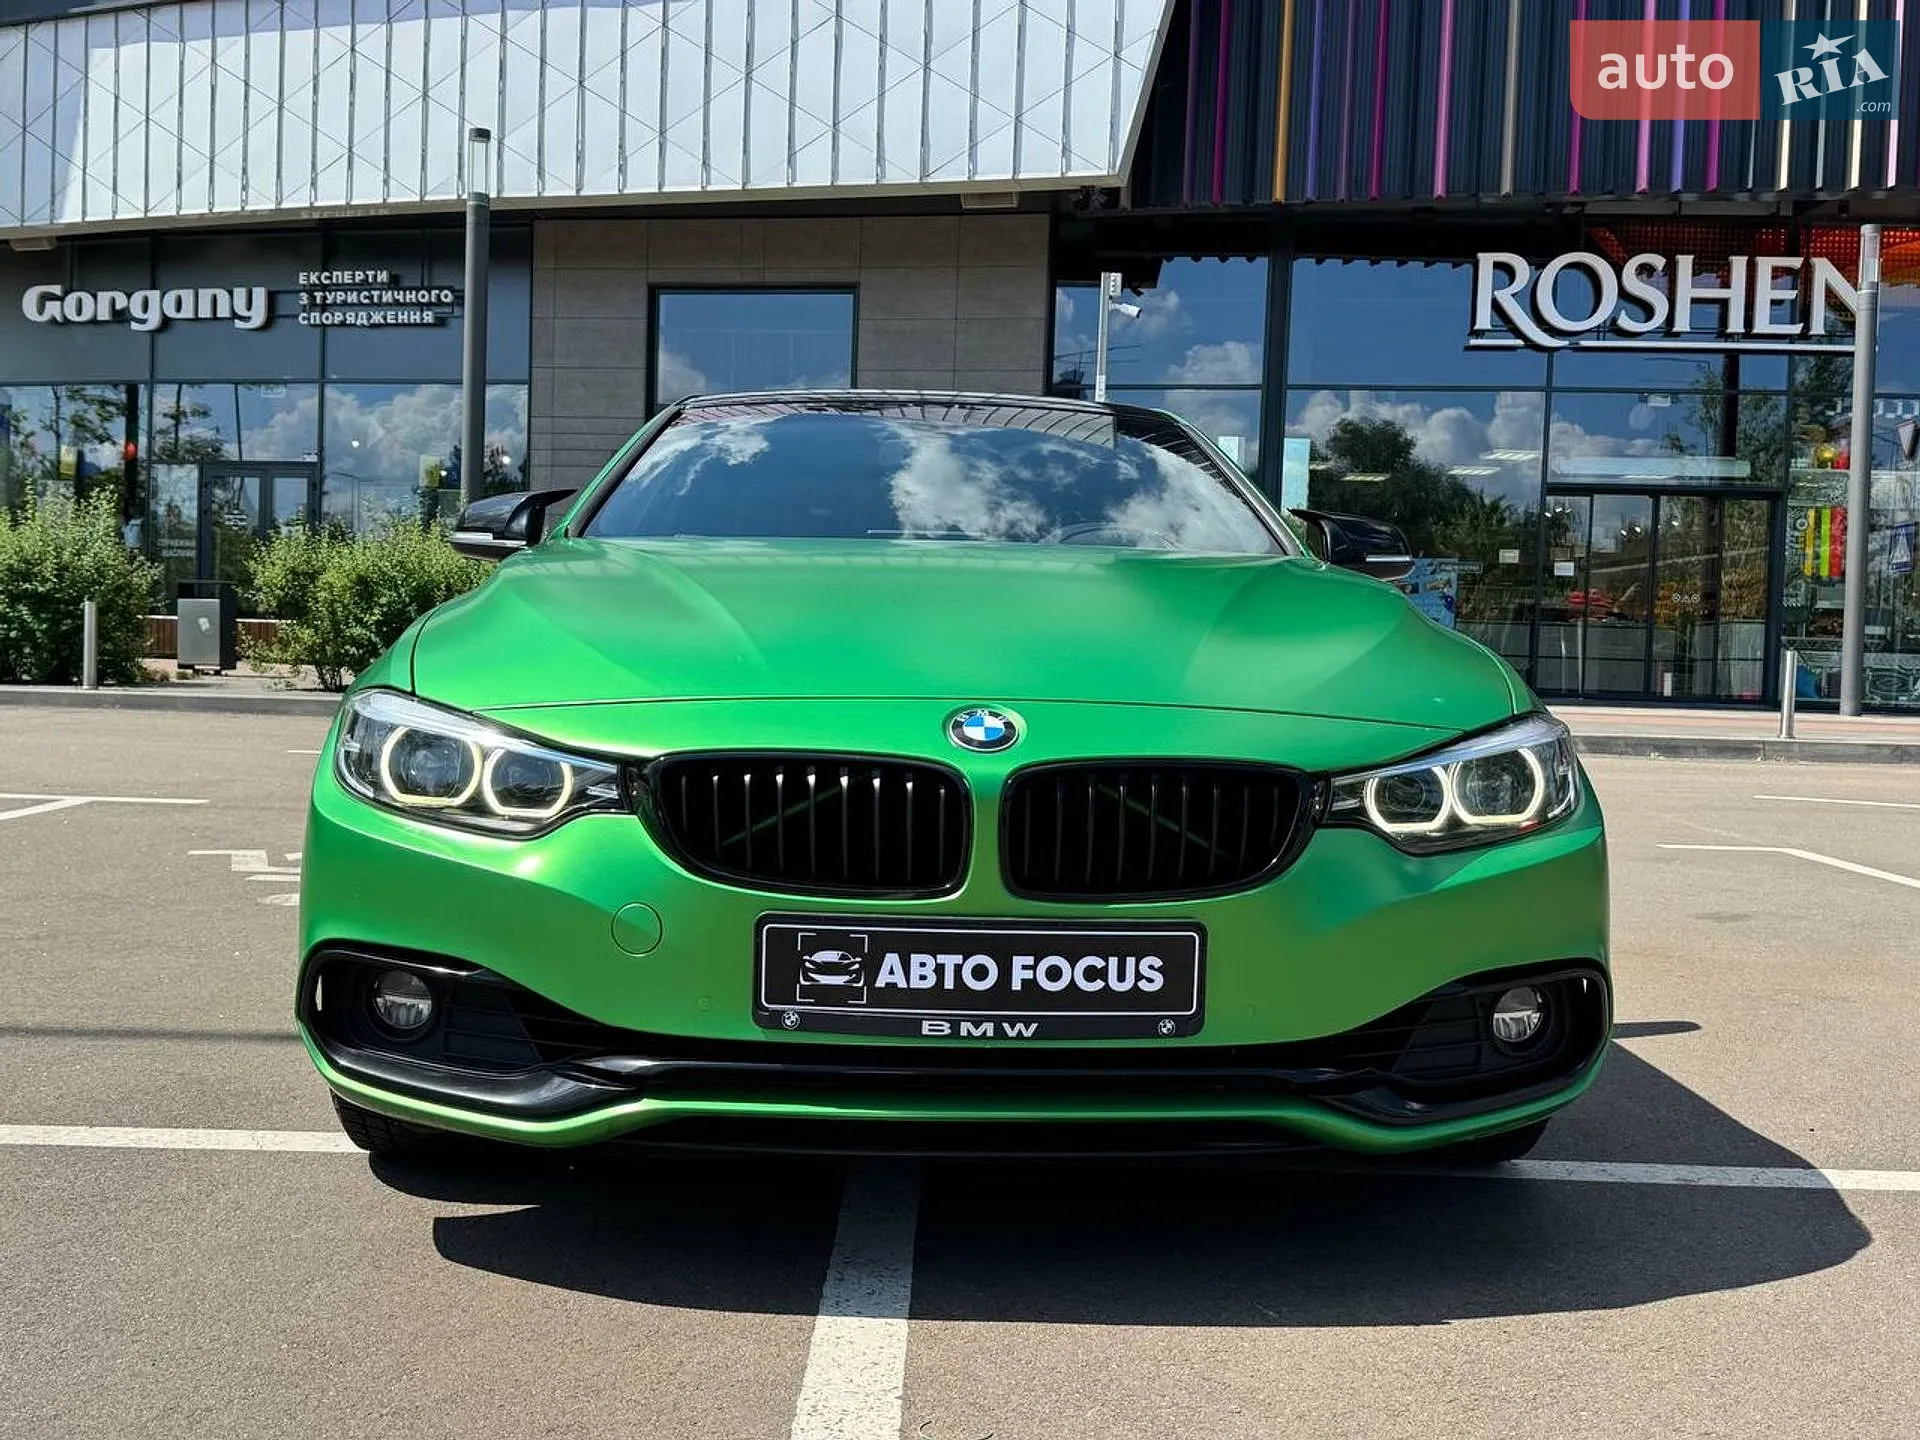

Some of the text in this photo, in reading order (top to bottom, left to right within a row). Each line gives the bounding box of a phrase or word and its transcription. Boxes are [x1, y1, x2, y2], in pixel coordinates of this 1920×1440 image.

[298, 270, 389, 285] ЕКСПЕРТИ
[314, 289, 454, 304] ТУРИСТИЧНОГО
[1473, 252, 1858, 346] ROSHEN
[22, 284, 269, 331] Gorgany
[298, 311, 435, 326] СПОРЯДЖЕННЯ
[874, 952, 1164, 992] АВТО FOCUS
[920, 1019, 1040, 1038] BMW
